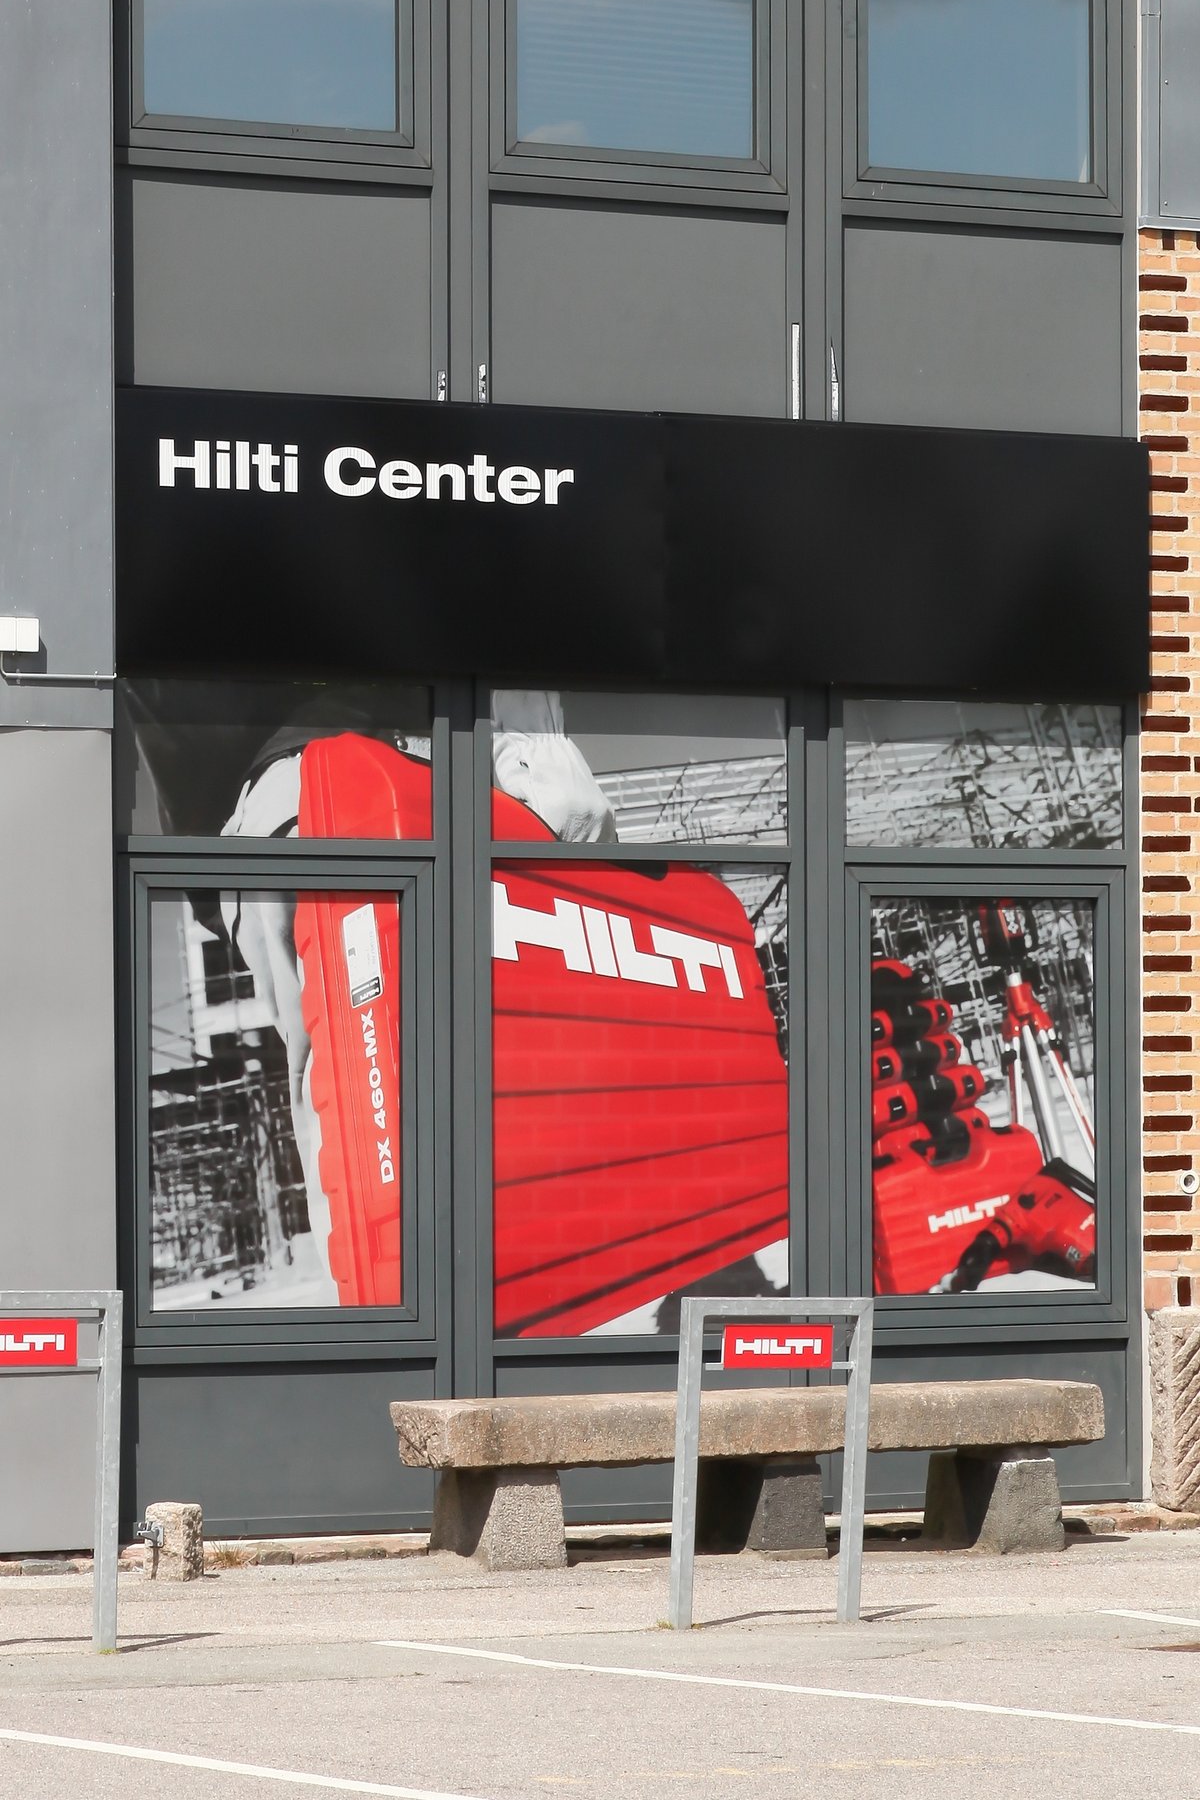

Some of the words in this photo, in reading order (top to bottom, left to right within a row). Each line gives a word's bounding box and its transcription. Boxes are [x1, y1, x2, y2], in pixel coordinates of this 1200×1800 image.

[158, 438, 299, 493] Hilti
[323, 446, 575, 505] Center
[491, 880, 744, 999] HILTI
[360, 1007, 387, 1131] 460-MX
[376, 1136, 396, 1185] DX
[735, 1338, 822, 1355] HILTI
